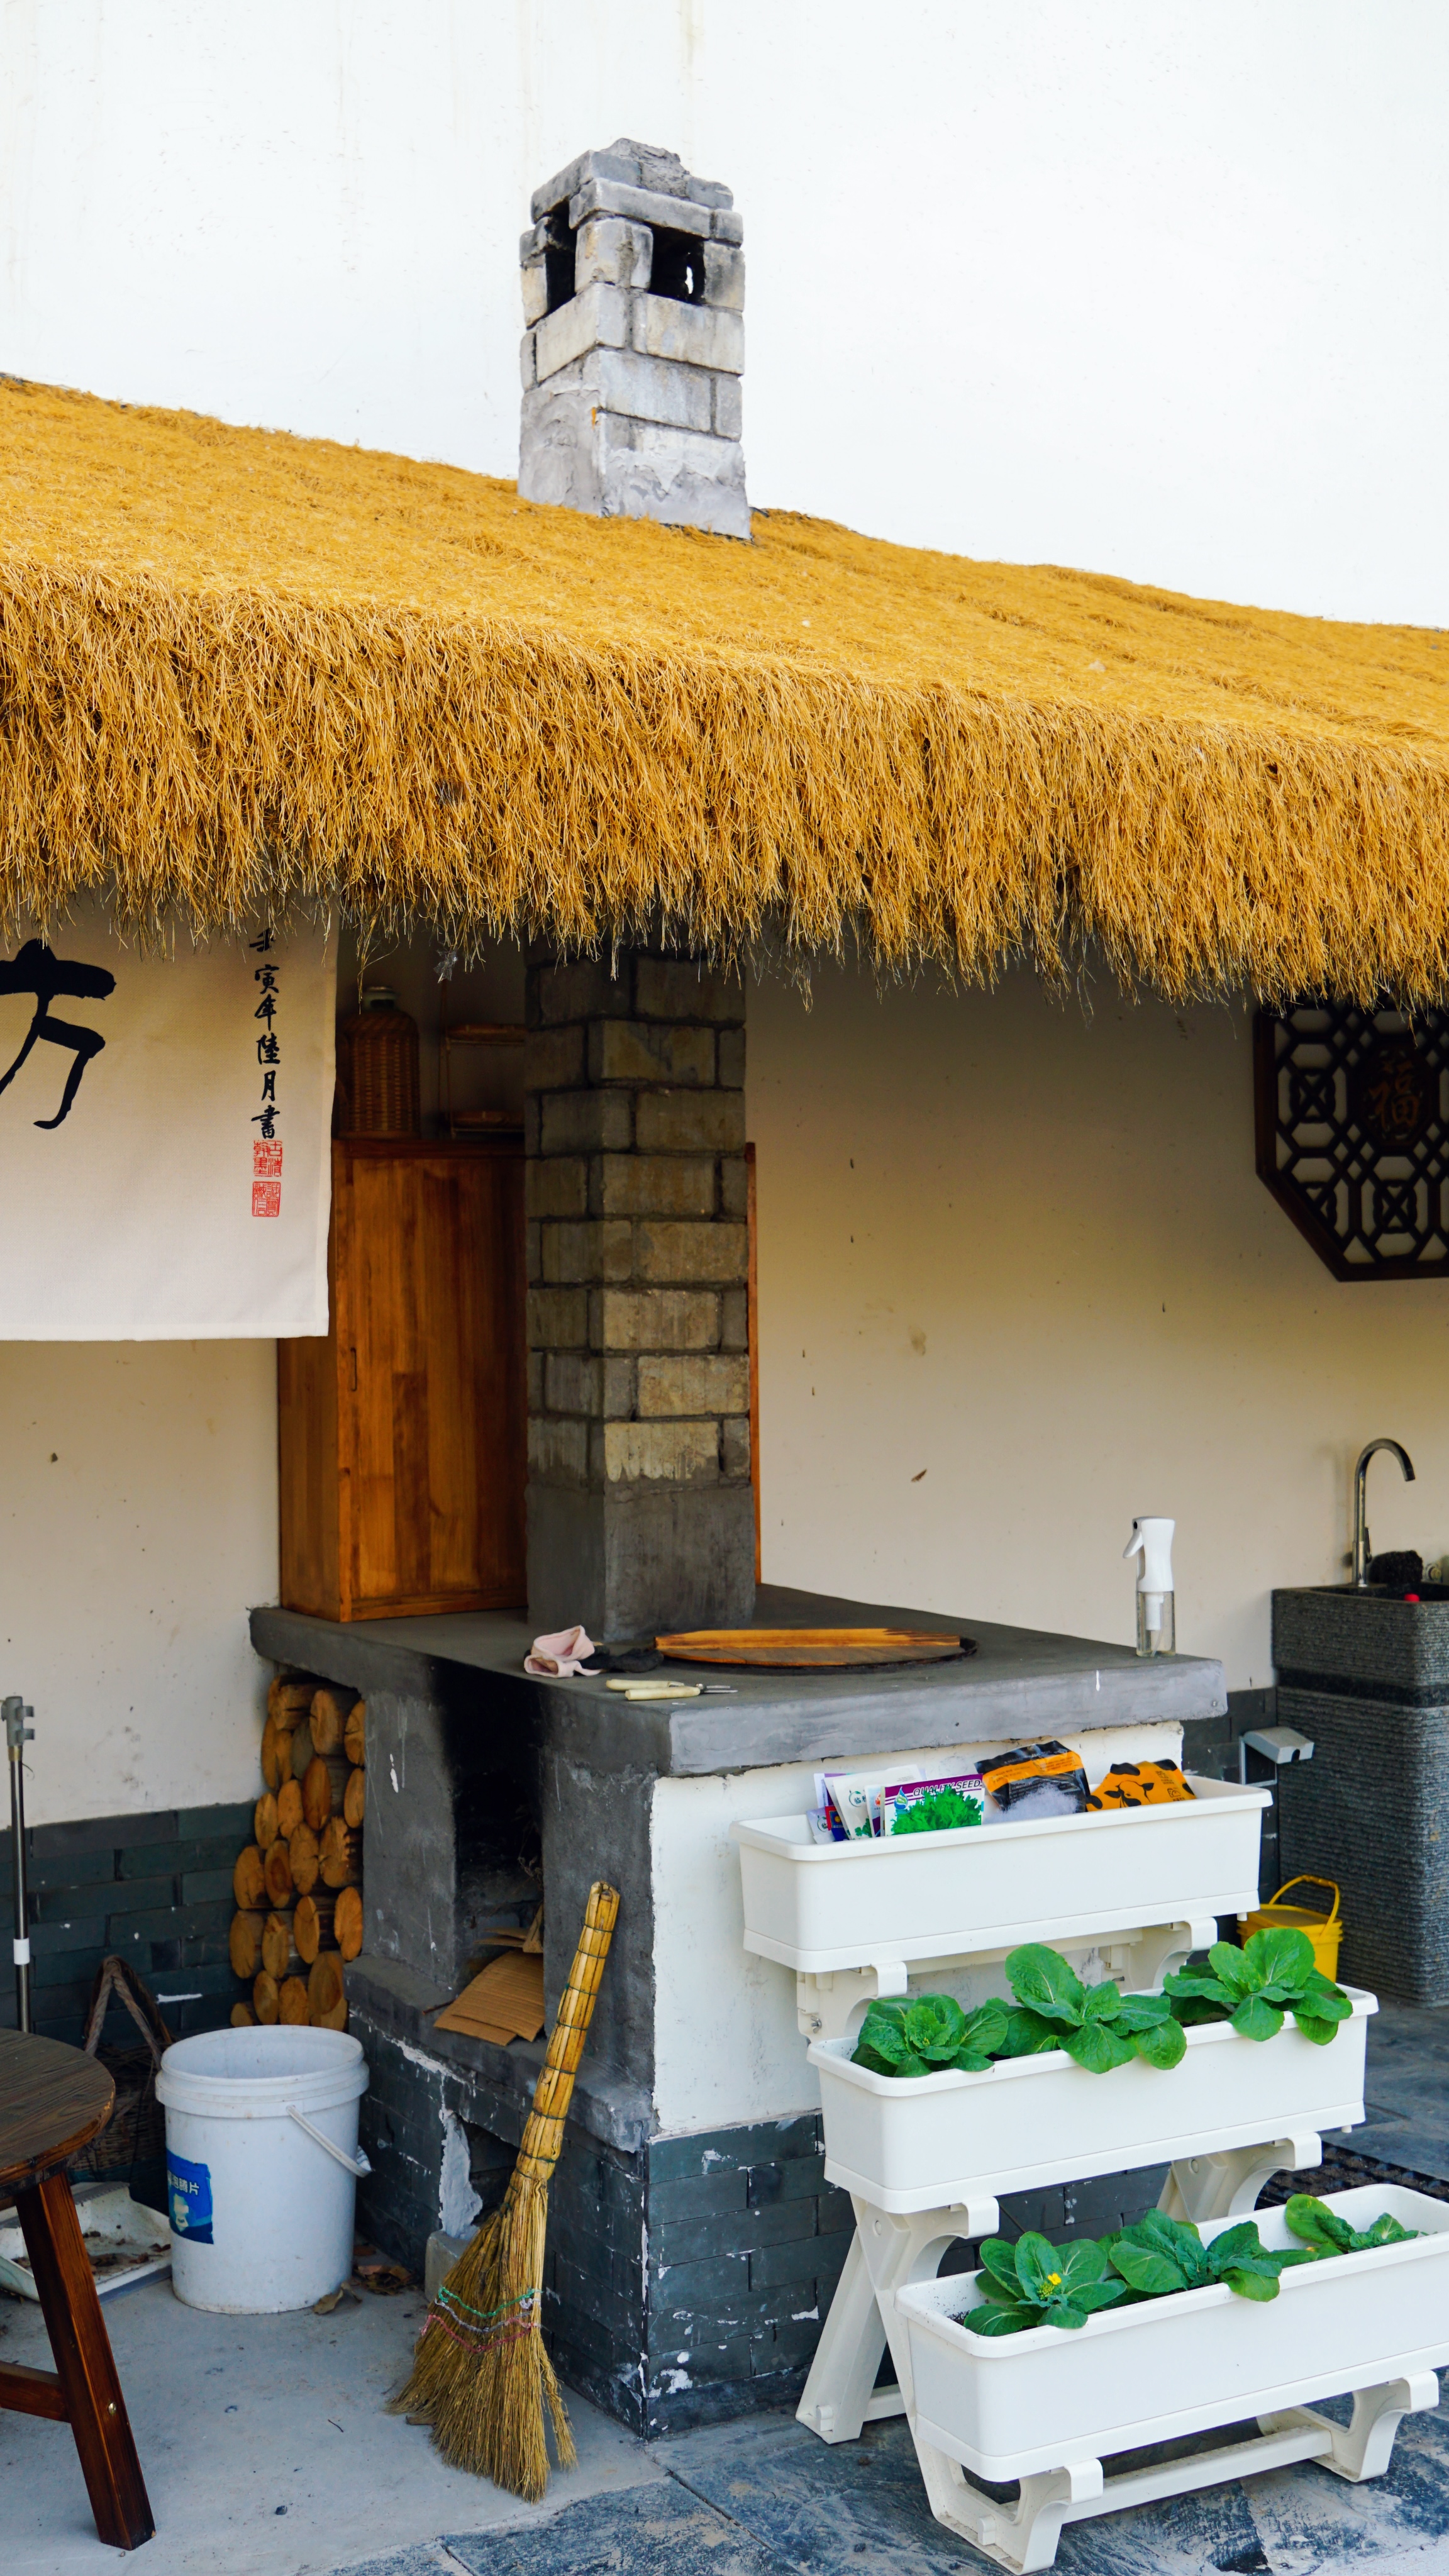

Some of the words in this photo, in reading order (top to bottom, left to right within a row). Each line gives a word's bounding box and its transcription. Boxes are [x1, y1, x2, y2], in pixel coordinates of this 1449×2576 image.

[0, 938, 117, 1130] 方
[1368, 1060, 1419, 1131] 福
[914, 1783, 954, 1796] QUALITY
